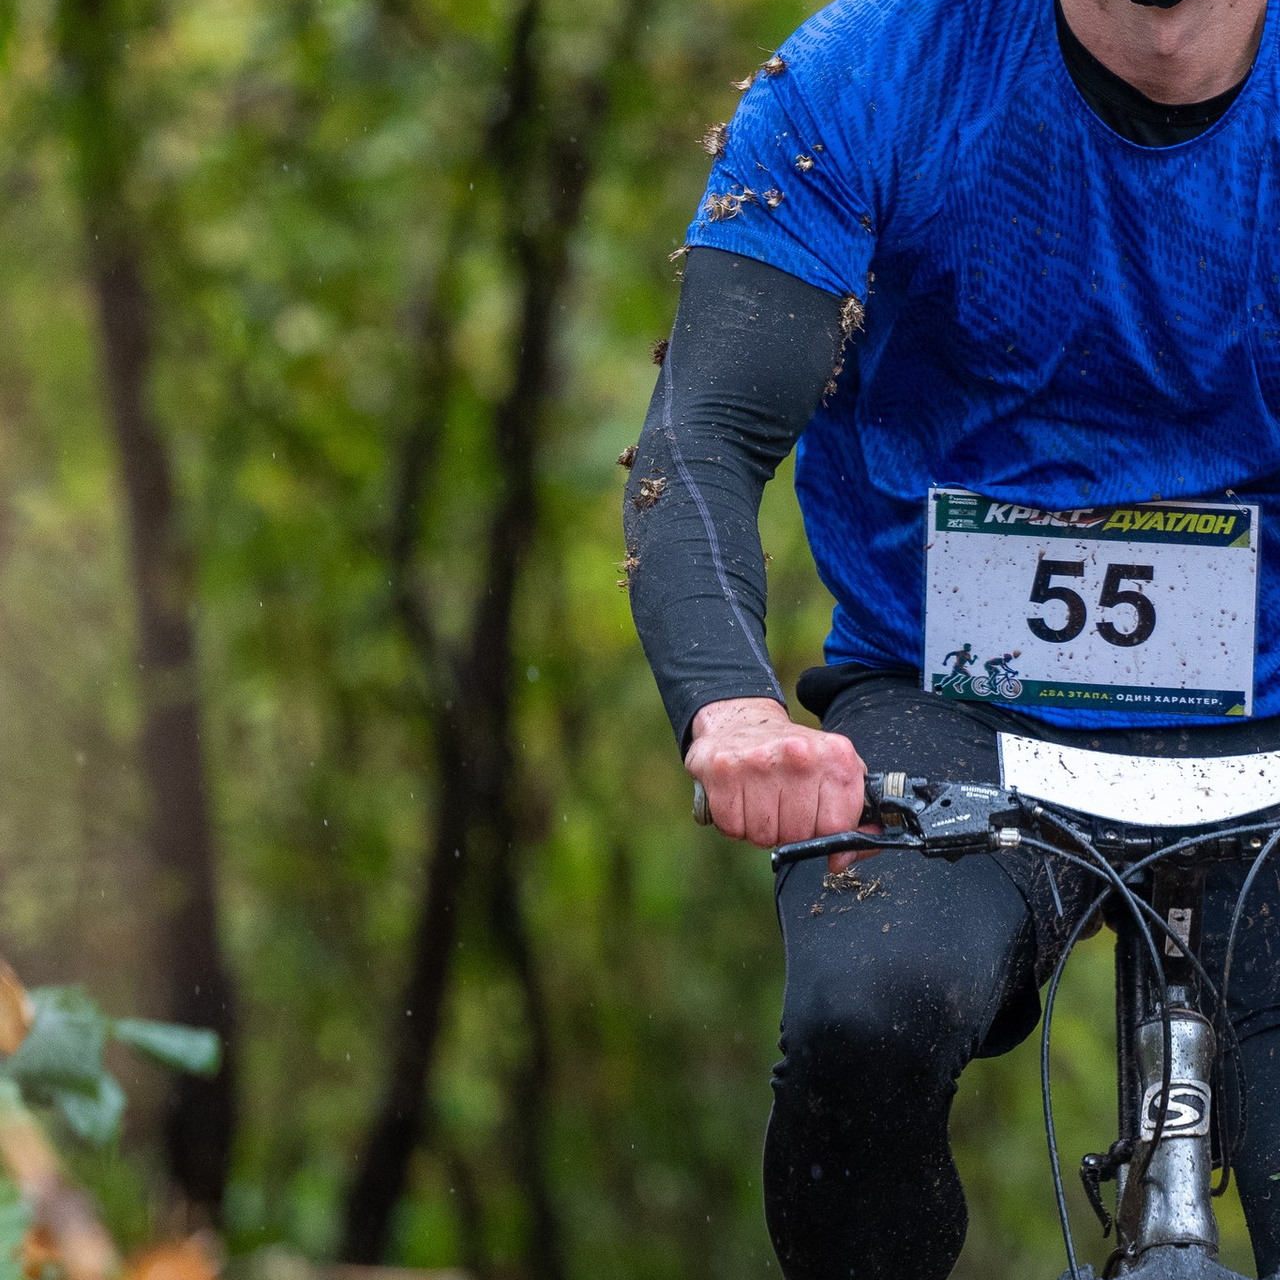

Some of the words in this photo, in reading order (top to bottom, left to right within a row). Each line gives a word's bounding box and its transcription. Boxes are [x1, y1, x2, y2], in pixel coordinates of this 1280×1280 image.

[1102, 510, 1236, 535] ДУАТЛОН
[1026, 560, 1156, 647] 55
[1116, 693, 1151, 702] ОДИН
[1154, 695, 1223, 706] ХАРАКТЕР.
[961, 785, 998, 797] SHIMANO
